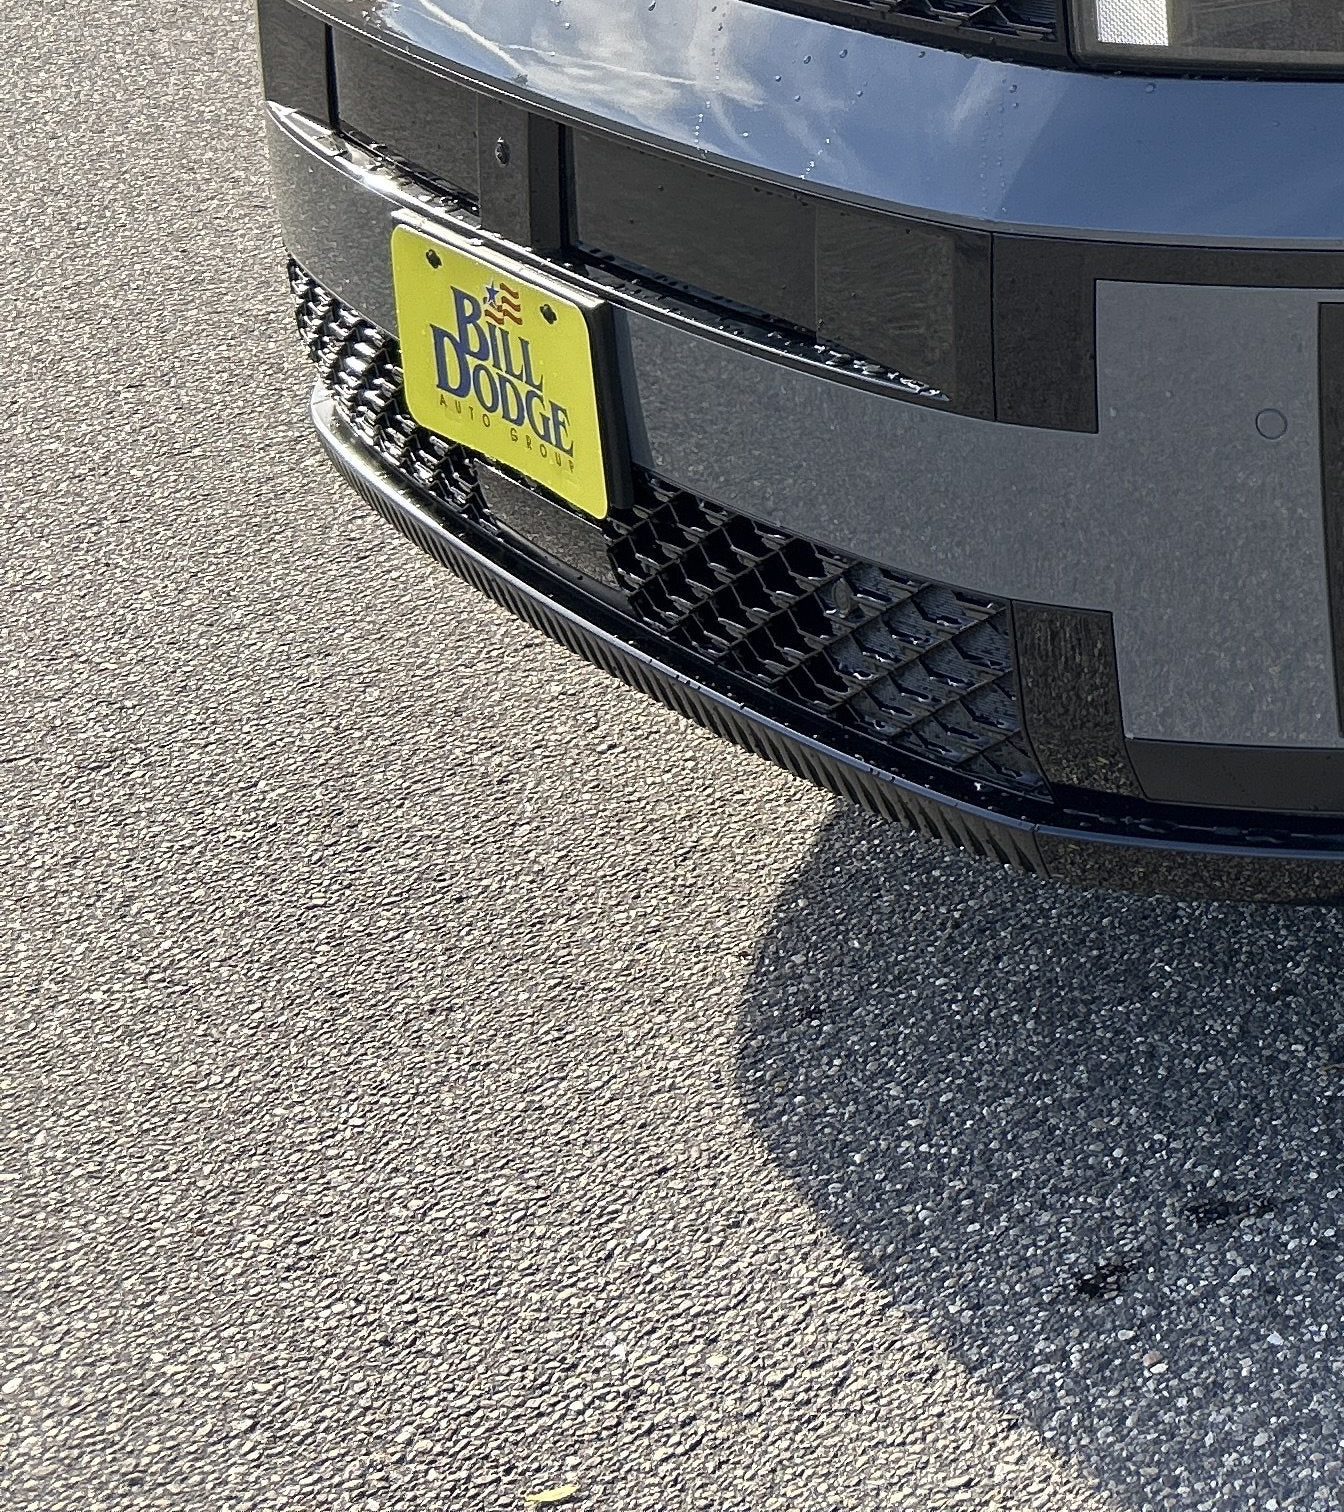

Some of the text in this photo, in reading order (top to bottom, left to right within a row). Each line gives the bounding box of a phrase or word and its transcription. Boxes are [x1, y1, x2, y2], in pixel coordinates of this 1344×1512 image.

[429, 323, 576, 457] DODGE
[450, 285, 544, 393] BILL
[439, 394, 576, 472] AUTO GROUP
